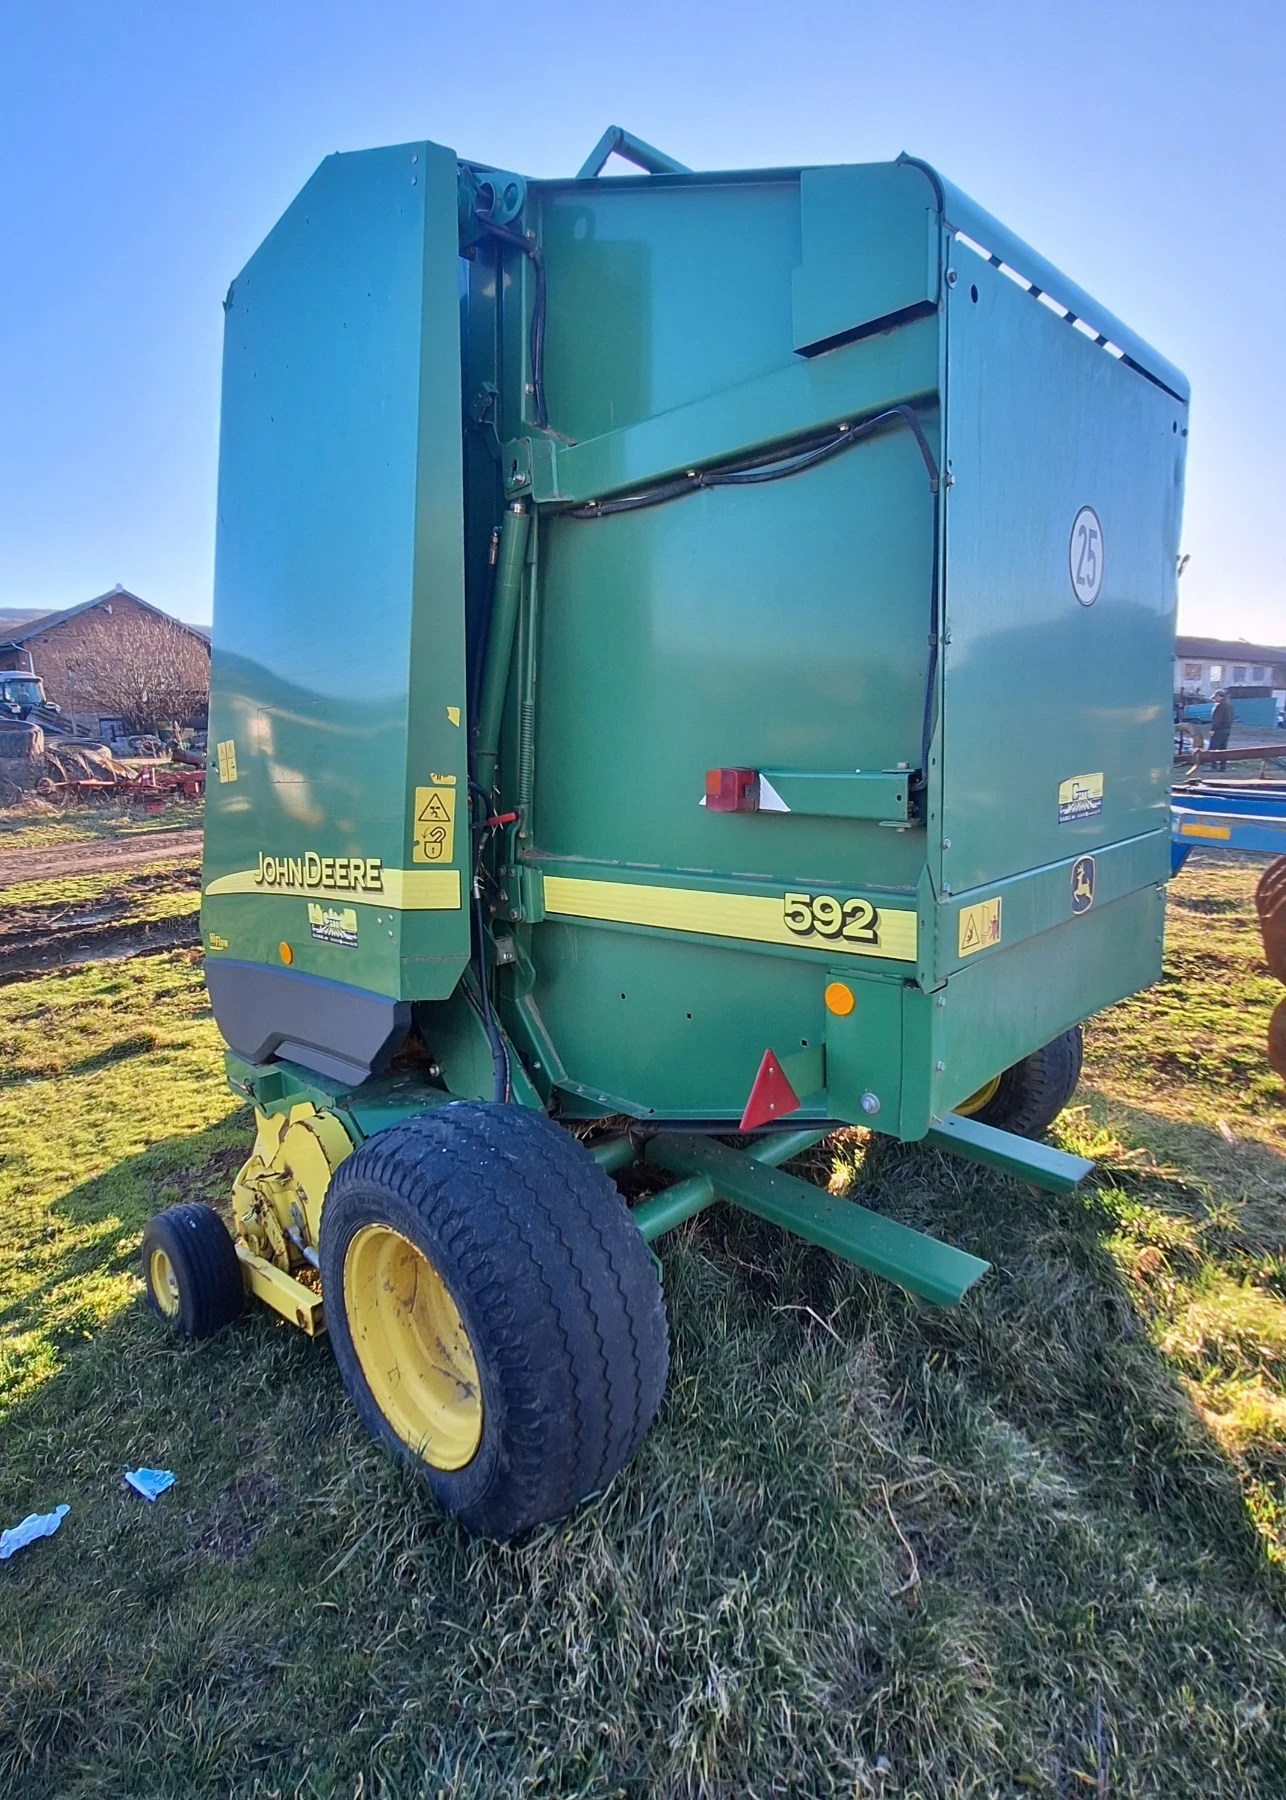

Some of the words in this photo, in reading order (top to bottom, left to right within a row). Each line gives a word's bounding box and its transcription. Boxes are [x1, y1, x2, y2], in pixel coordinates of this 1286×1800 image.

[1076, 524, 1098, 588] 25
[254, 851, 303, 886] JOHN
[304, 851, 383, 892] DEERE
[784, 893, 878, 944] 592
